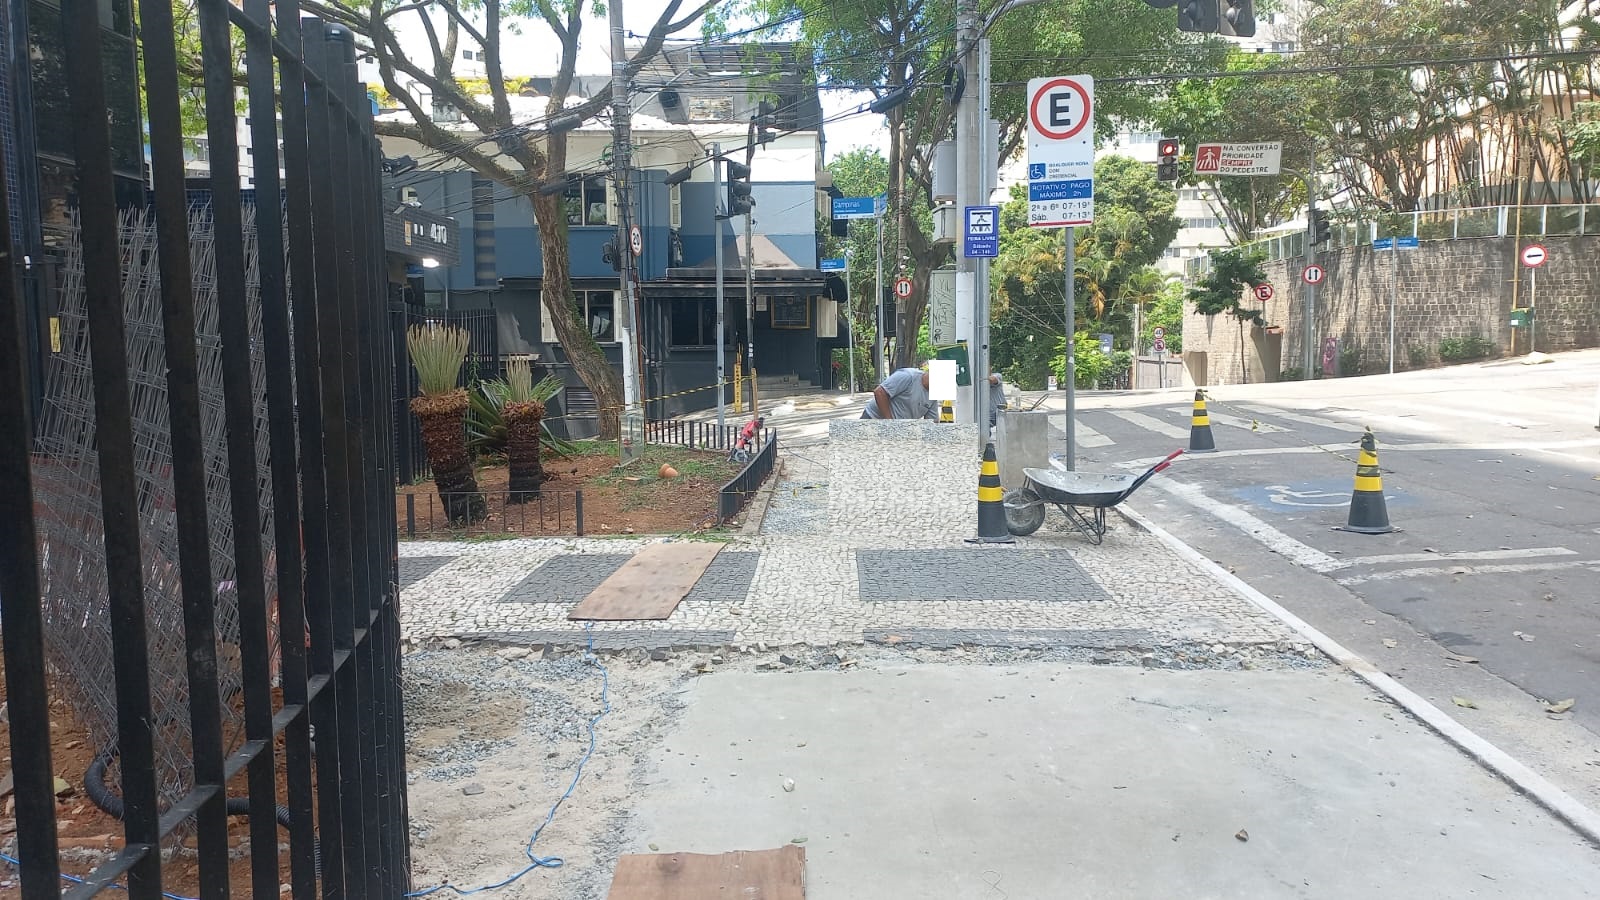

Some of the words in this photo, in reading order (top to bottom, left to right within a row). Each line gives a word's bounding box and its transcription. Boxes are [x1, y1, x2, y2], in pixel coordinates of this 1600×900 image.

[1050, 93, 1070, 126] E
[1237, 143, 1278, 151] CONVERSÃO
[1040, 190, 1066, 198] MÁXIMO
